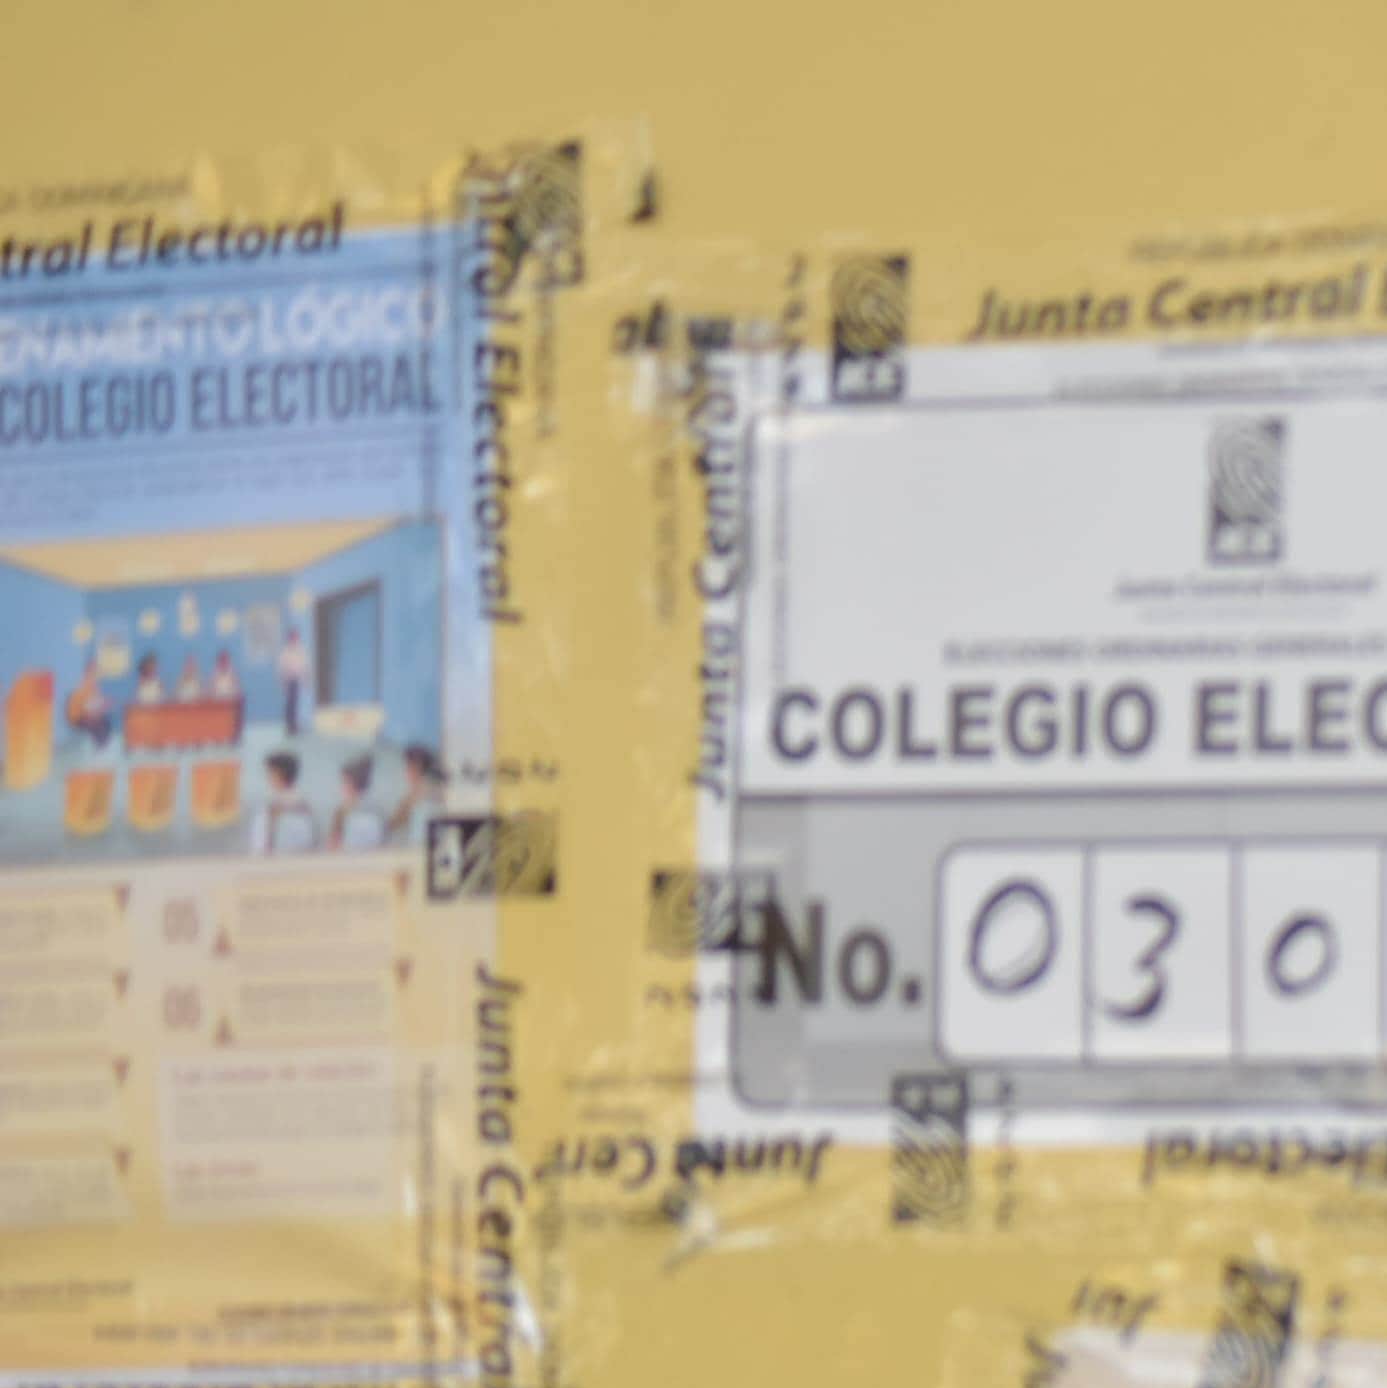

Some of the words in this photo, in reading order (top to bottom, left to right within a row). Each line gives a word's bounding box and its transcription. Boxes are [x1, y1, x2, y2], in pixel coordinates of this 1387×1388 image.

[107, 201, 345, 272] Electoral
[964, 288, 1131, 342] Junta
[1147, 262, 1367, 330] Central
[0, 366, 176, 447] COLEGIO
[191, 354, 438, 432] ELECTORAL
[768, 680, 1157, 762] COLEGIO
[755, 897, 925, 1008] No.
[473, 963, 523, 1145] Junta
